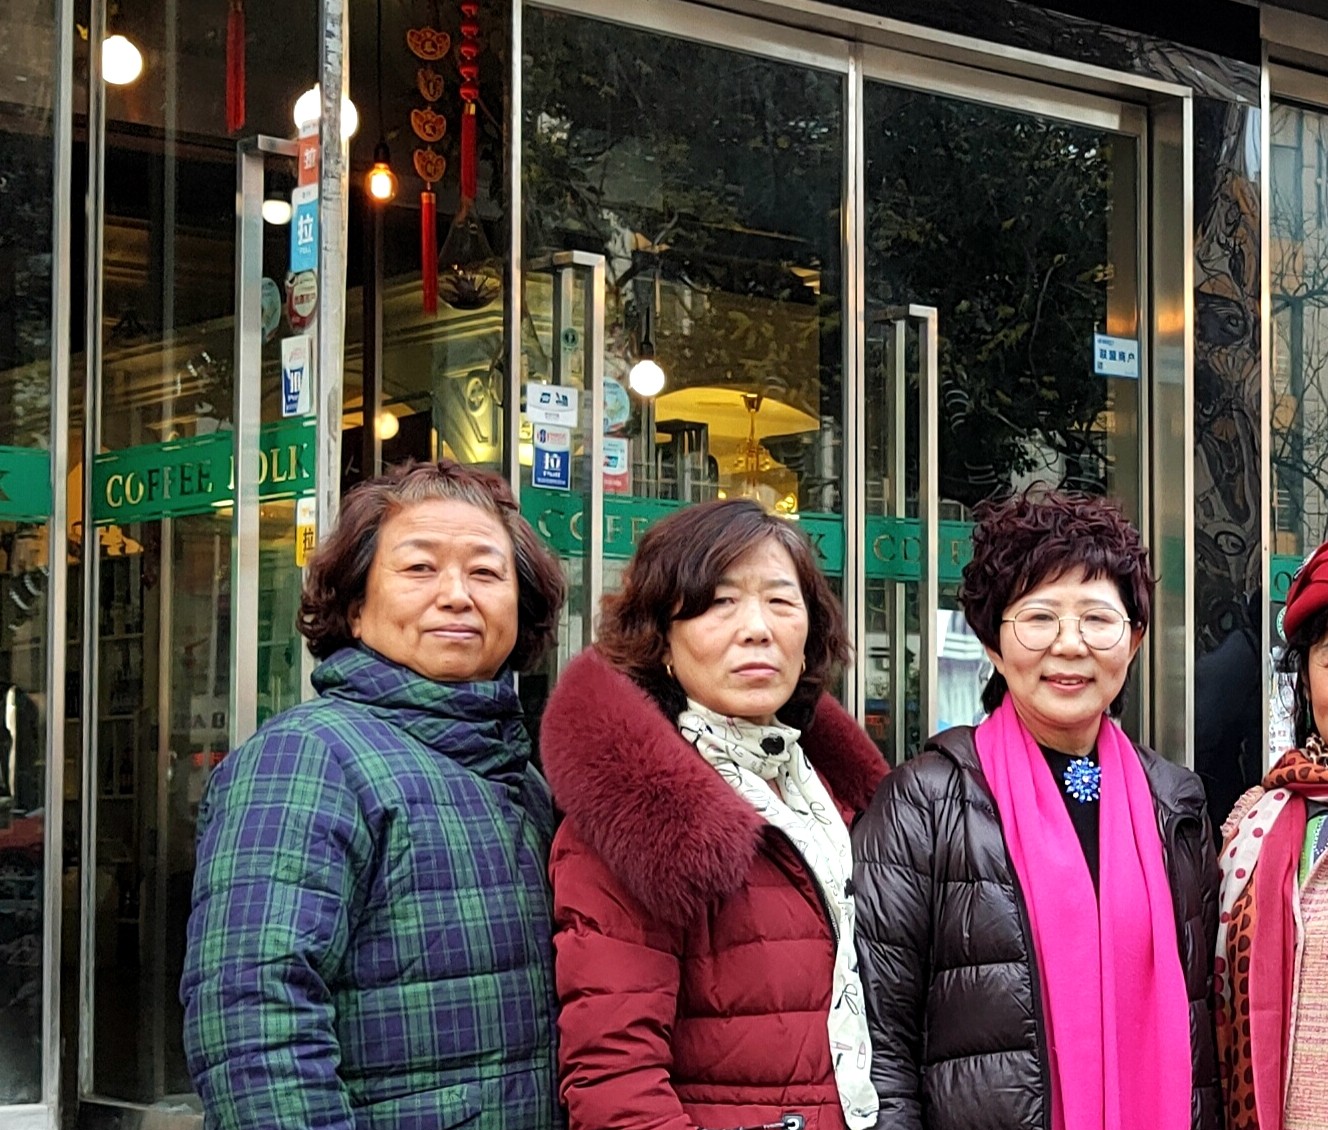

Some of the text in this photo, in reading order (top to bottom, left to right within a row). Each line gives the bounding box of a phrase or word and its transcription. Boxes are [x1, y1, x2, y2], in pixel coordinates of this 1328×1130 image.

[298, 213, 314, 245] 拉
[106, 459, 213, 508] COFFEE
[303, 527, 314, 551] 拉
